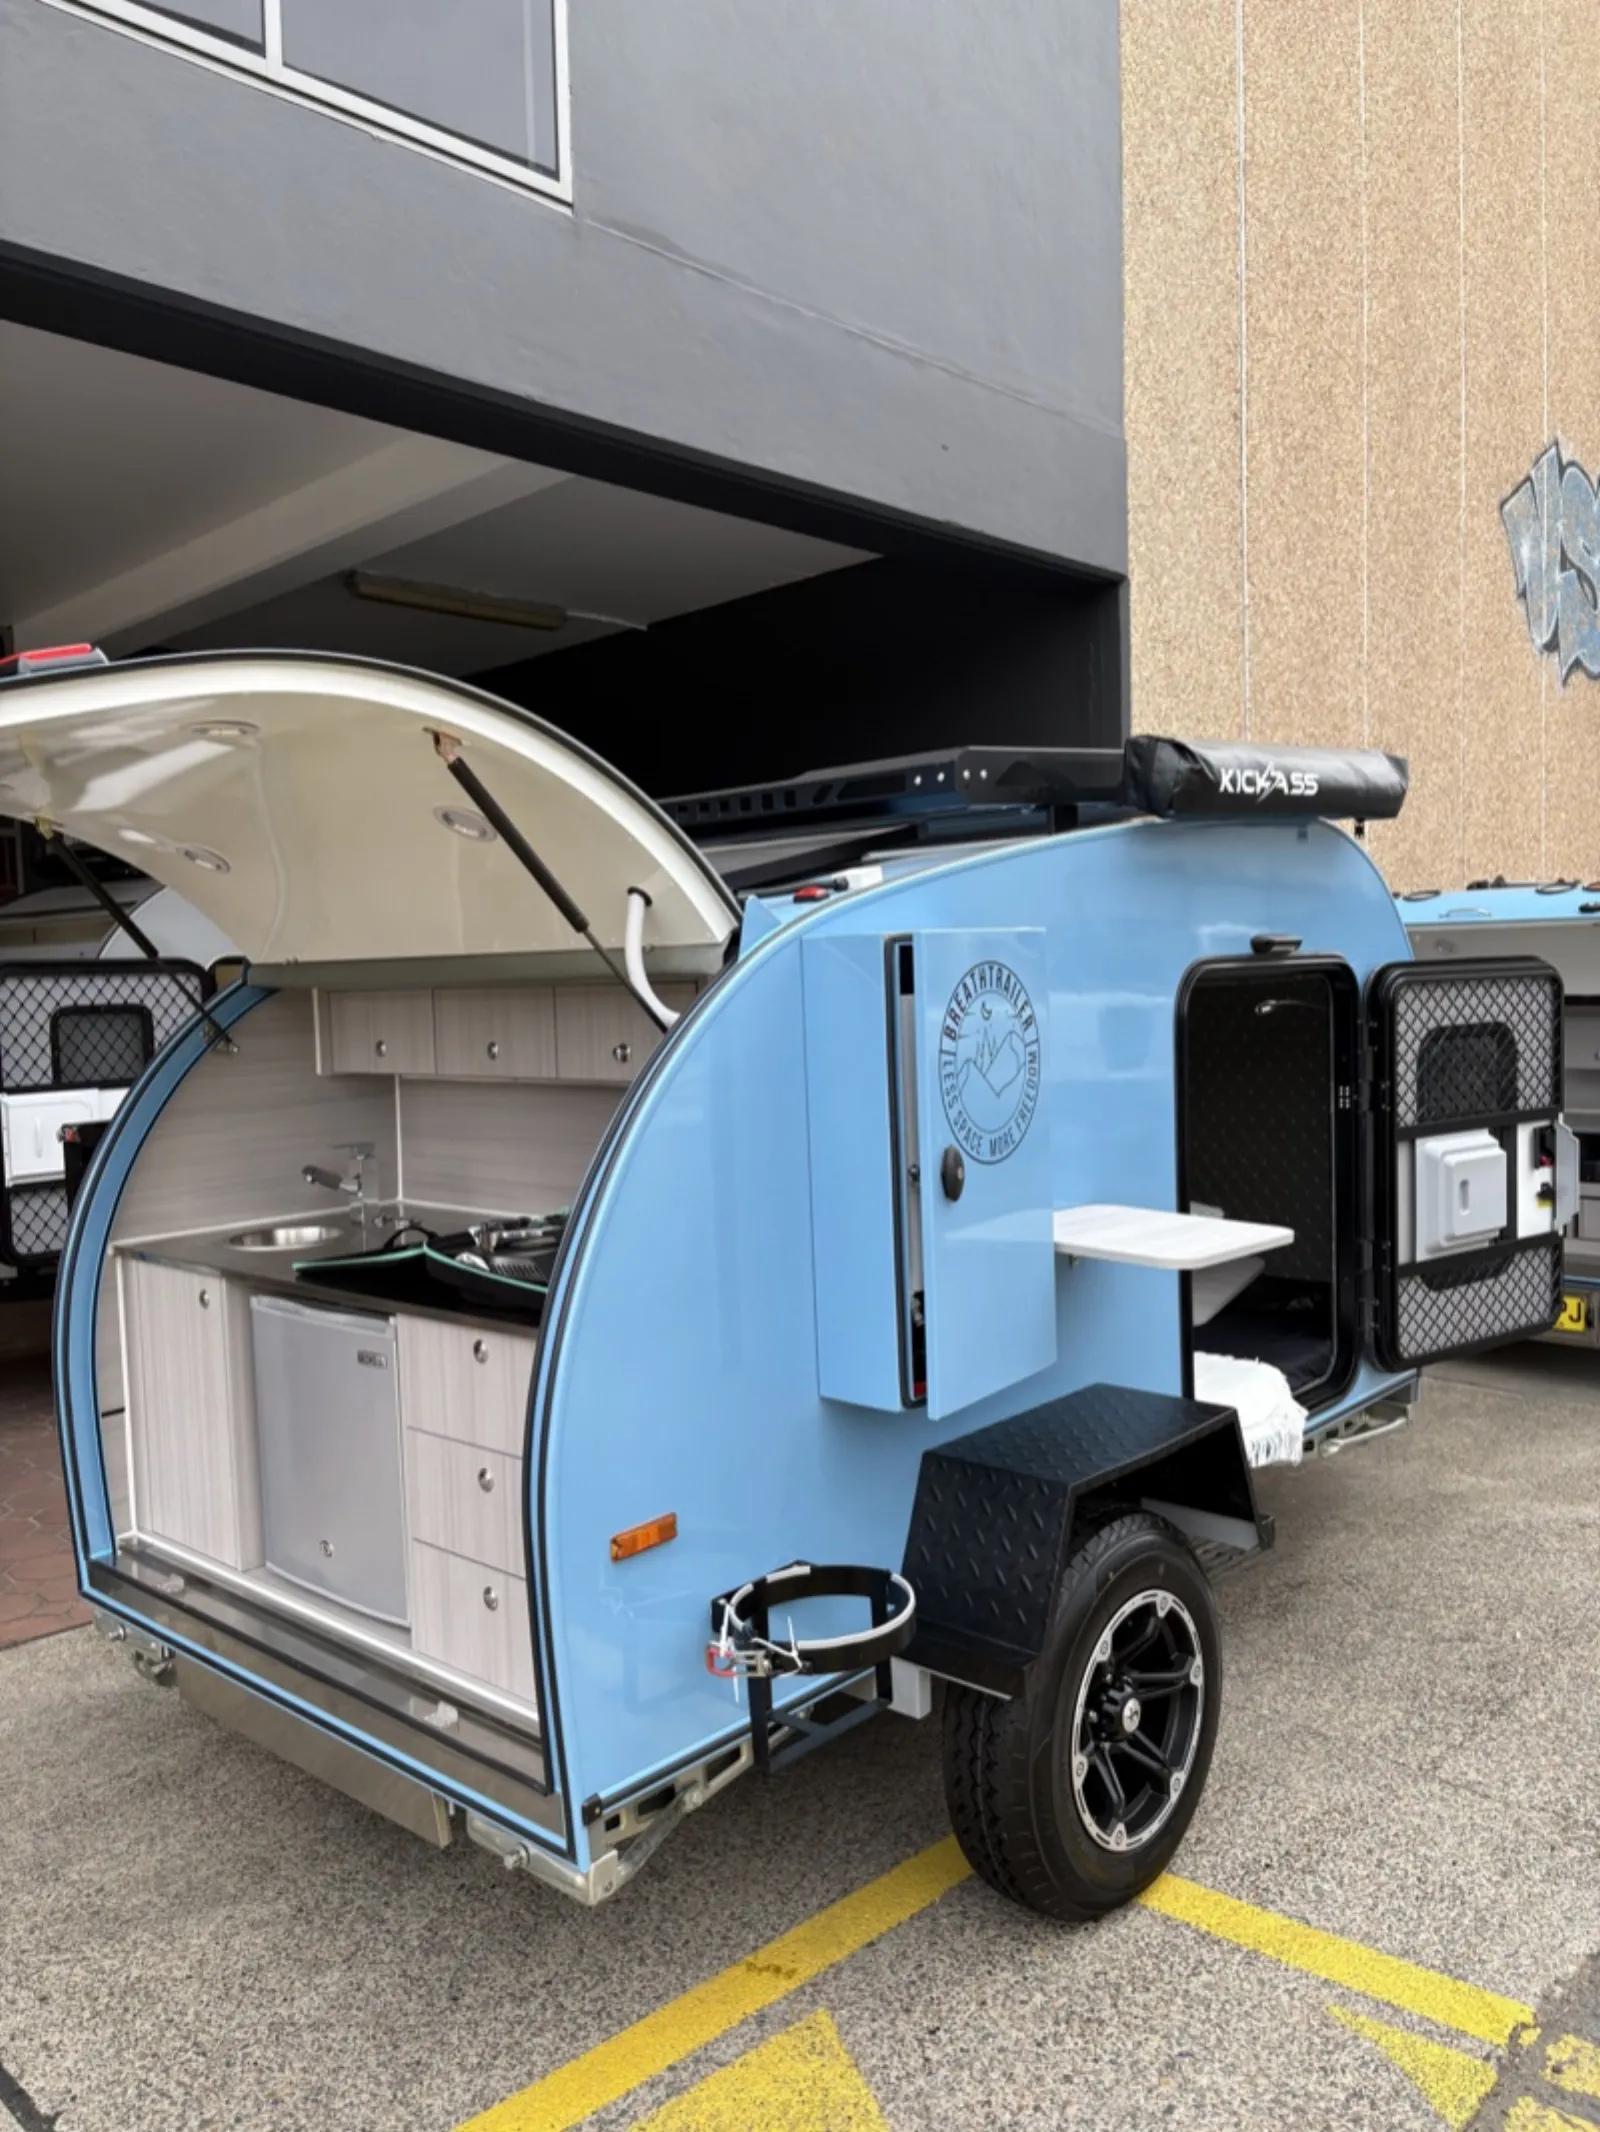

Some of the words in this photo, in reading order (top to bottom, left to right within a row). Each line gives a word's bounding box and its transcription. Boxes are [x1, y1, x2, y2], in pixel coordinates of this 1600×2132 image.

[1218, 763, 1320, 801] KICKASS
[944, 965, 1034, 1041] BREATHTRAILER
[943, 1060, 959, 1109] LESS
[952, 1109, 984, 1156] SPACE
[988, 1126, 1017, 1157] MORE
[1014, 1050, 1038, 1133] FREEDOM
